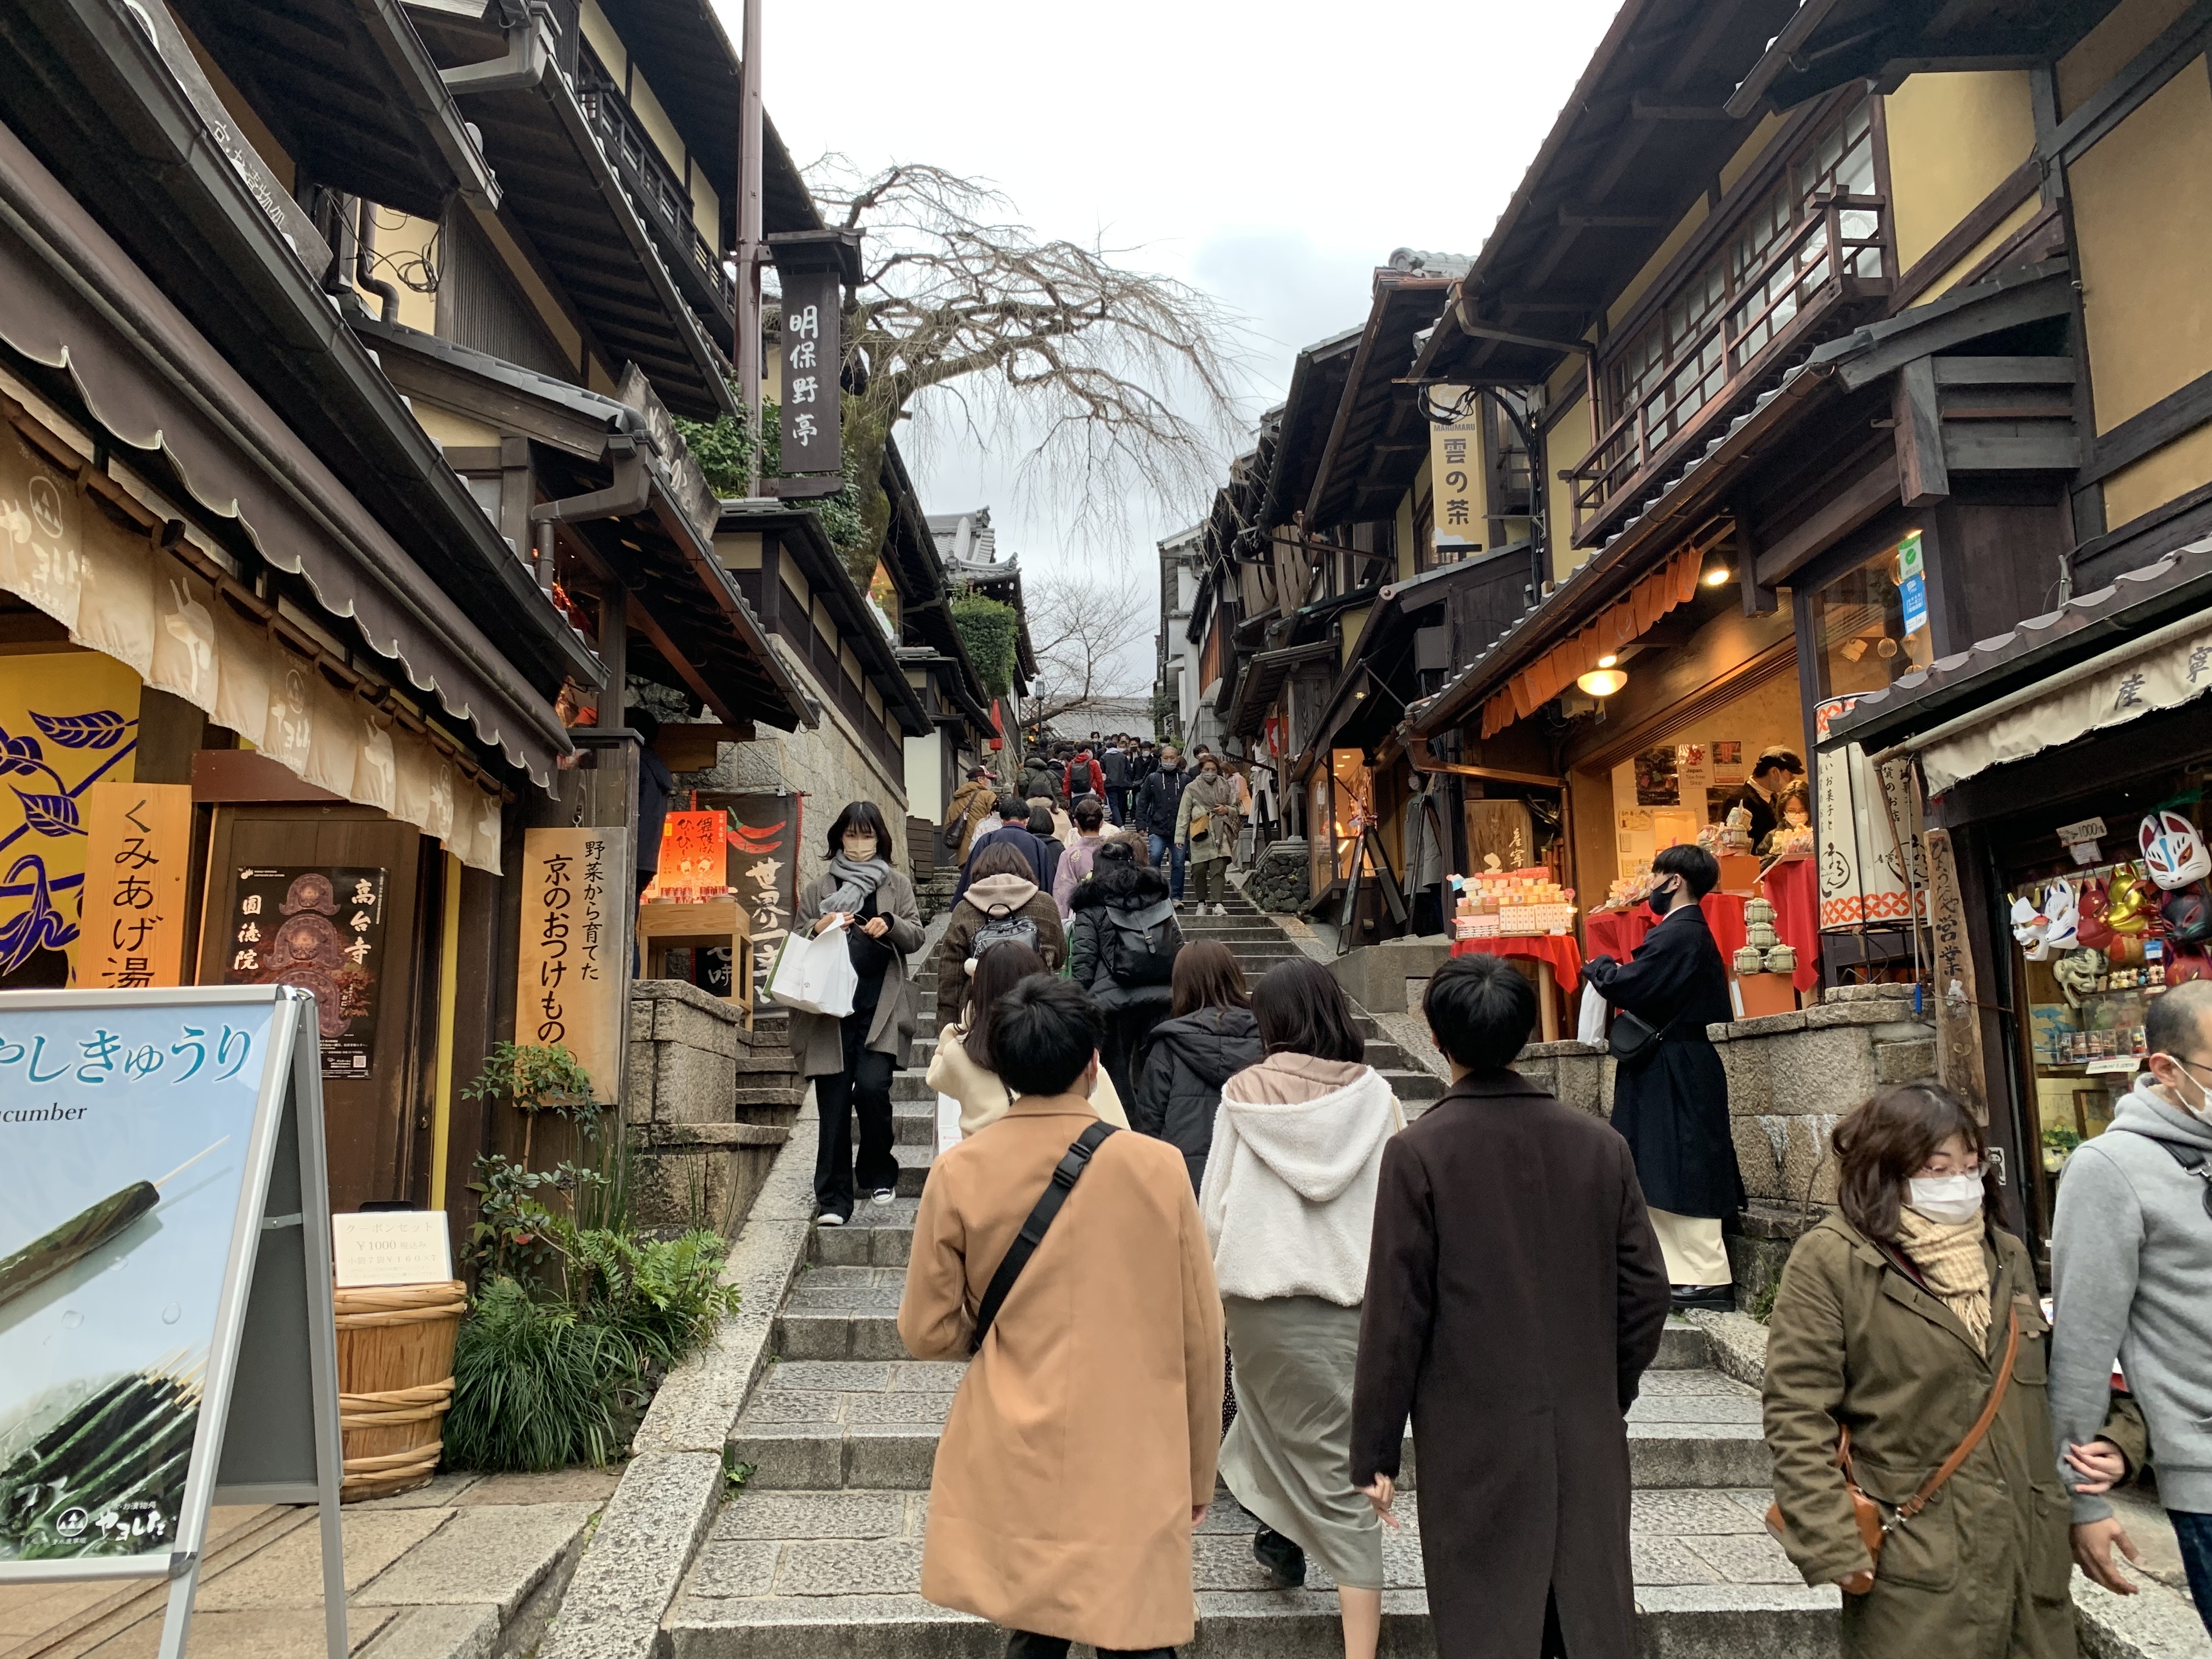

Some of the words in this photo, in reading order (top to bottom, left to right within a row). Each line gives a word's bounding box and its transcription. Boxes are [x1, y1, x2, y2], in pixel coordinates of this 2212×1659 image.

[790, 305, 818, 447] 明保野亭
[1434, 424, 1475, 432] MARUMARU
[1444, 438, 1469, 525] 雲の茶
[1882, 760, 1900, 822] 貨のお店
[345, 878, 376, 965] 高台寺
[538, 854, 574, 1044] 京のおつけもの
[582, 840, 606, 980] 野菜から育てた
[0, 1103, 87, 1123] cumber
[347, 1221, 432, 1234] クーポンセット
